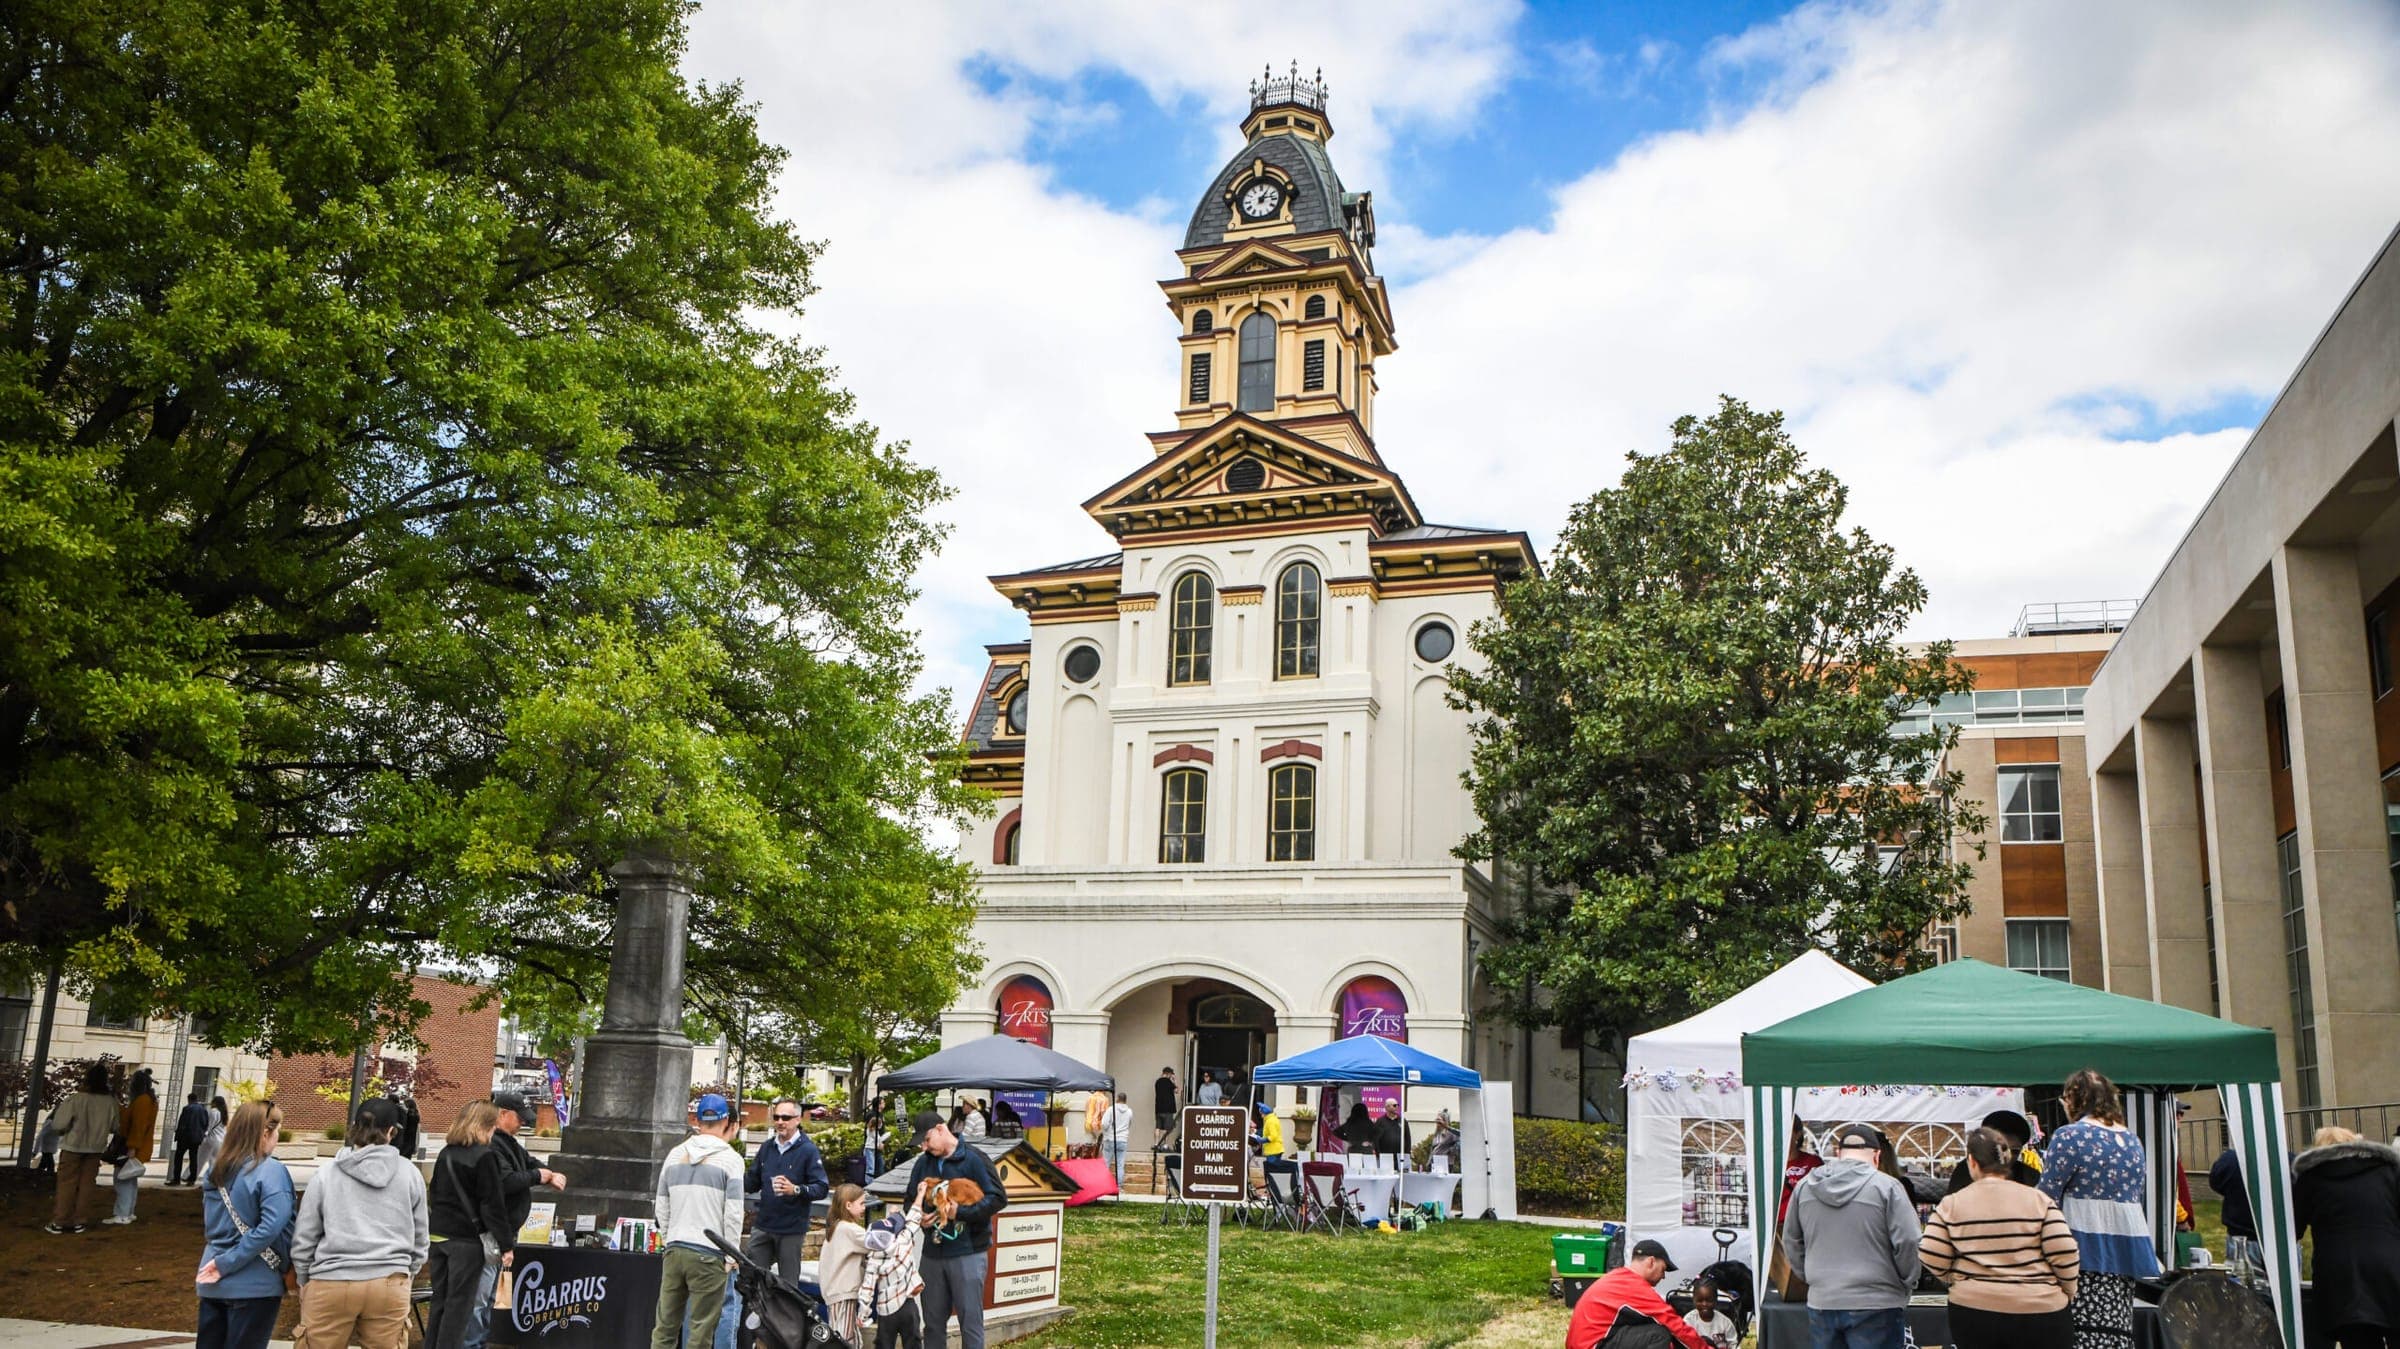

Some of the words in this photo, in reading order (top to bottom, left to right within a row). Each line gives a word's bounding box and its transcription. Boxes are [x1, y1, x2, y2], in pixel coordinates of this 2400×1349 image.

[1003, 1001, 1048, 1026] ARTS
[1347, 1008, 1401, 1034] ARTS
[1195, 1114, 1235, 1124] CABARRUS
[1200, 1127, 1230, 1137] COUNTY
[1190, 1140, 1240, 1150] COURTHOUSE
[1204, 1152, 1223, 1162] MAIN
[1194, 1165, 1234, 1176] ENTRANCE
[1013, 1225, 1034, 1233] Handmade
[1016, 1254, 1027, 1262] Come
[512, 1261, 608, 1332] CABARRUS
[535, 1303, 580, 1324] BREWING
[586, 1302, 600, 1313] CO
